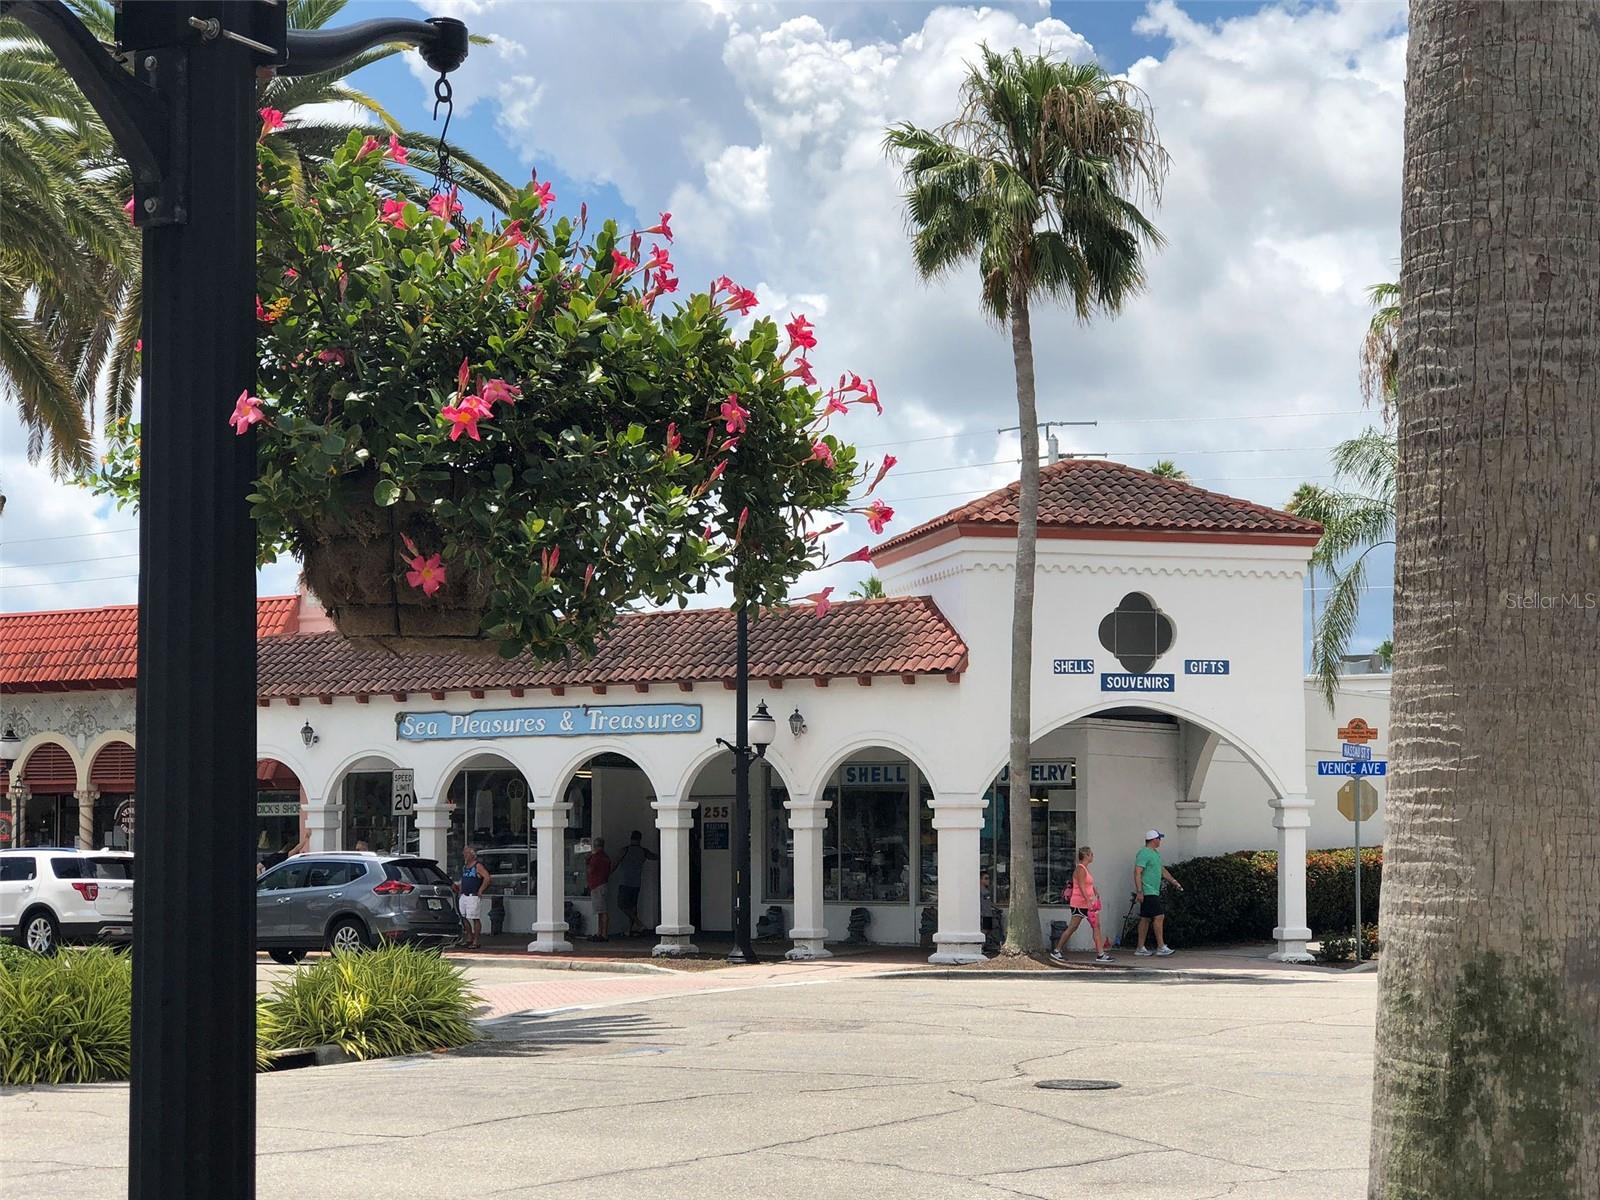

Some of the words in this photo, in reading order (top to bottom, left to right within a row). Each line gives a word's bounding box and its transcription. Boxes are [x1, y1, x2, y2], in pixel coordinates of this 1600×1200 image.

[1054, 660, 1094, 673] SHELLS
[1190, 661, 1224, 673] GIFTS
[1106, 676, 1170, 689] SOUVENIRS
[402, 716, 439, 737] Sea
[450, 714, 547, 735] Pleasures
[560, 711, 575, 731] &
[587, 709, 698, 731] Treasures
[846, 767, 906, 782] SHELL
[1001, 765, 1069, 781] JELRY
[1321, 762, 1357, 774] VENICE
[1360, 762, 1381, 774] AVE
[395, 774, 412, 782] SPEED
[396, 783, 410, 791] LIMIT
[395, 793, 411, 810] 20
[704, 806, 729, 818] 255
